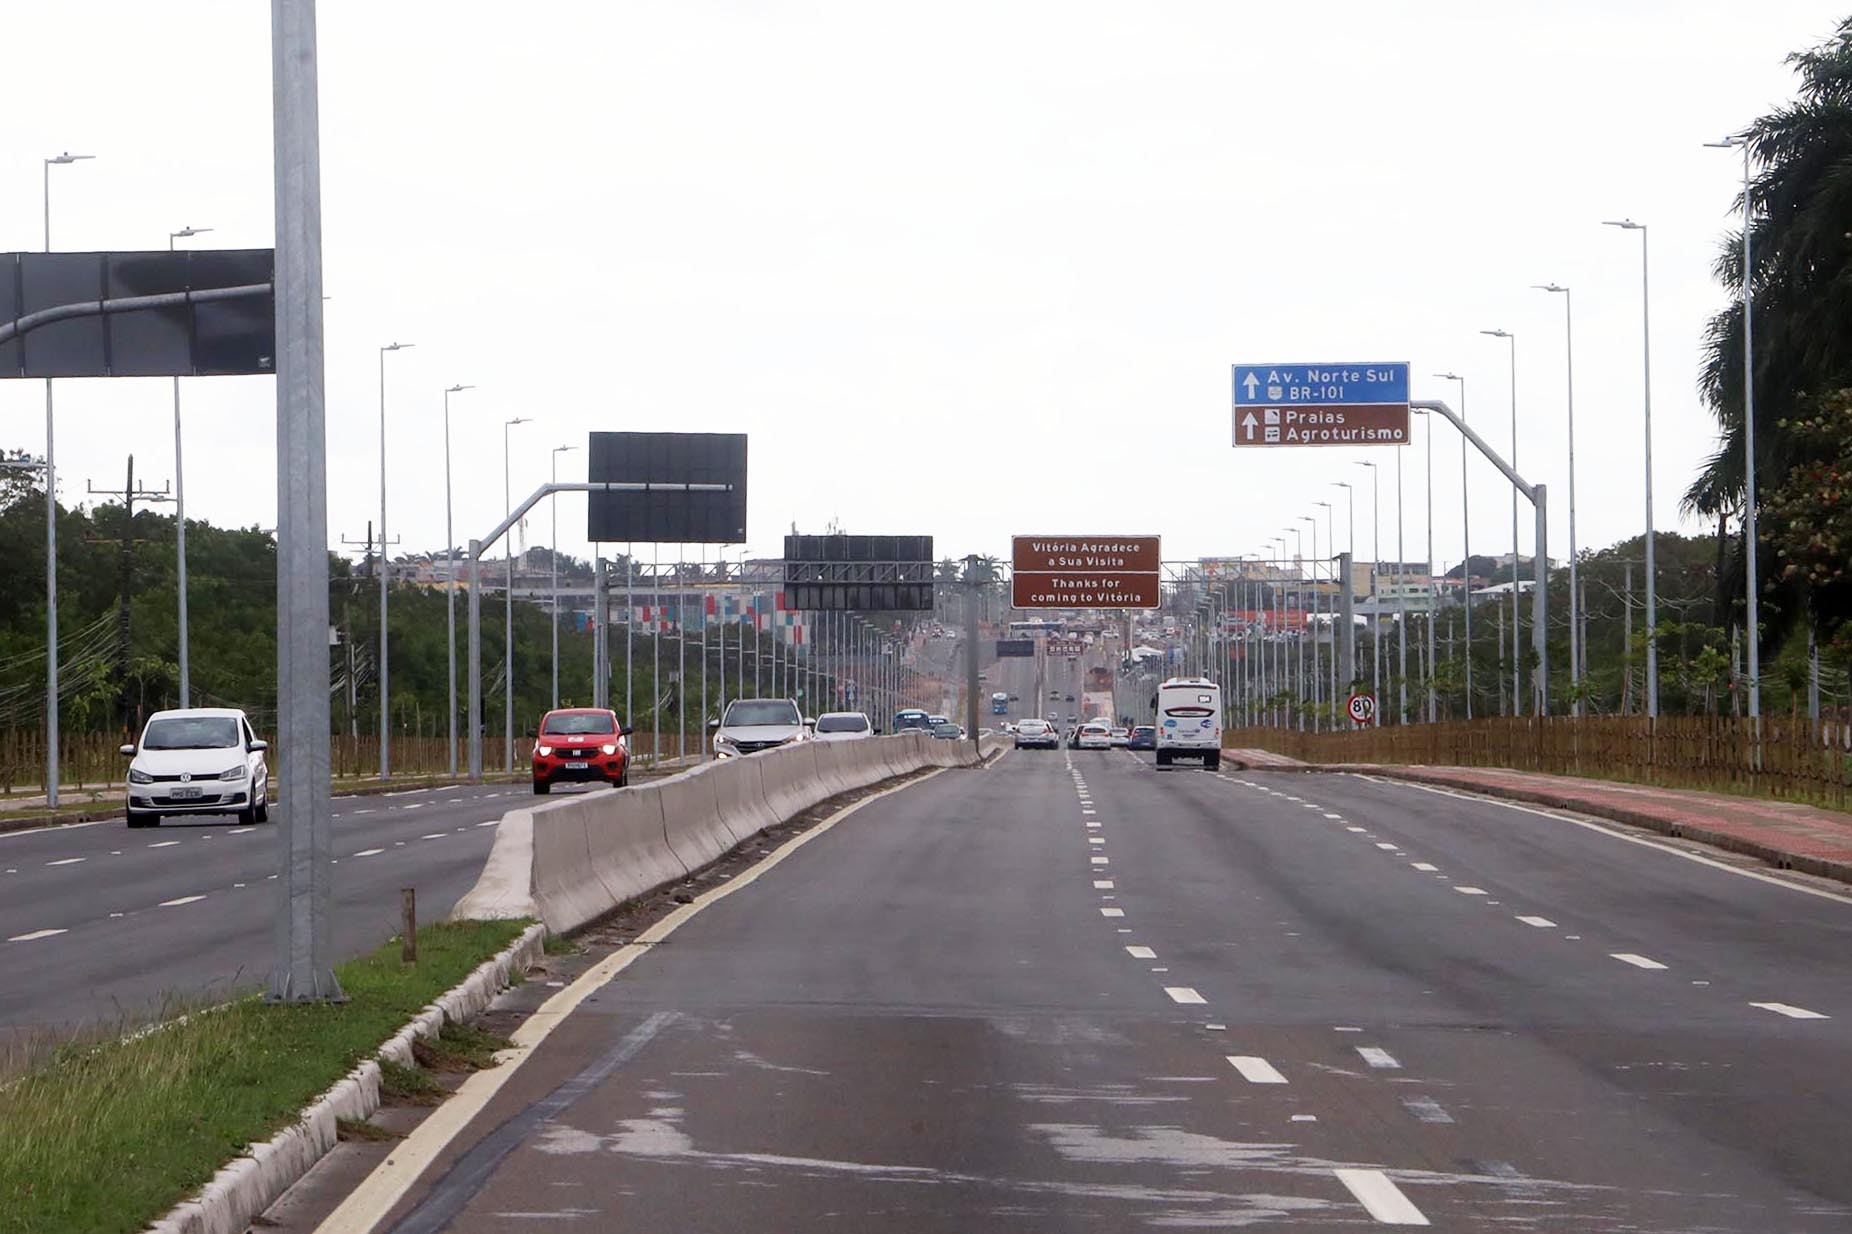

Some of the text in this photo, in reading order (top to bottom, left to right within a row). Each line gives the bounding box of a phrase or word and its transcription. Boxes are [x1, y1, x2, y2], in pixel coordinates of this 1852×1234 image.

[1268, 369, 1394, 383] Av. Norte Sul
[1290, 386, 1344, 400] BR-101
[1286, 411, 1345, 424] Praias
[1286, 427, 1403, 443] Agroturismo
[1032, 541, 1140, 554] Vitória Agradece
[1048, 556, 1124, 566] a Sua Visita
[1051, 578, 1120, 588] Thanks for
[1031, 591, 1141, 603] coming to Vitória
[1353, 699, 1371, 712] 80
